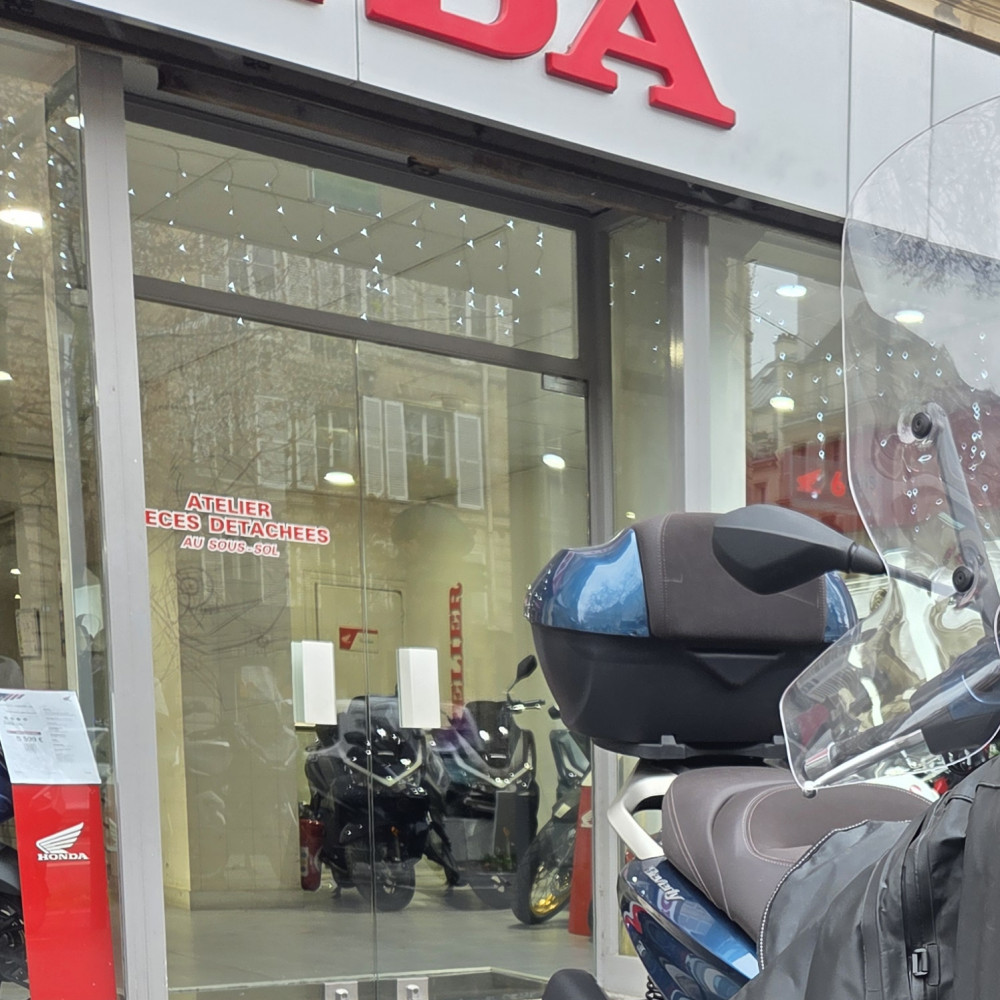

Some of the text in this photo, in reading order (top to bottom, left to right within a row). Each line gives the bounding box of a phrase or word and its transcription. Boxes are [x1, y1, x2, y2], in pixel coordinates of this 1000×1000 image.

[186, 493, 272, 519] ATELIER
[145, 508, 330, 545] ECES DETACHEES
[181, 536, 205, 550] AU
[37, 852, 90, 861] HONDA
